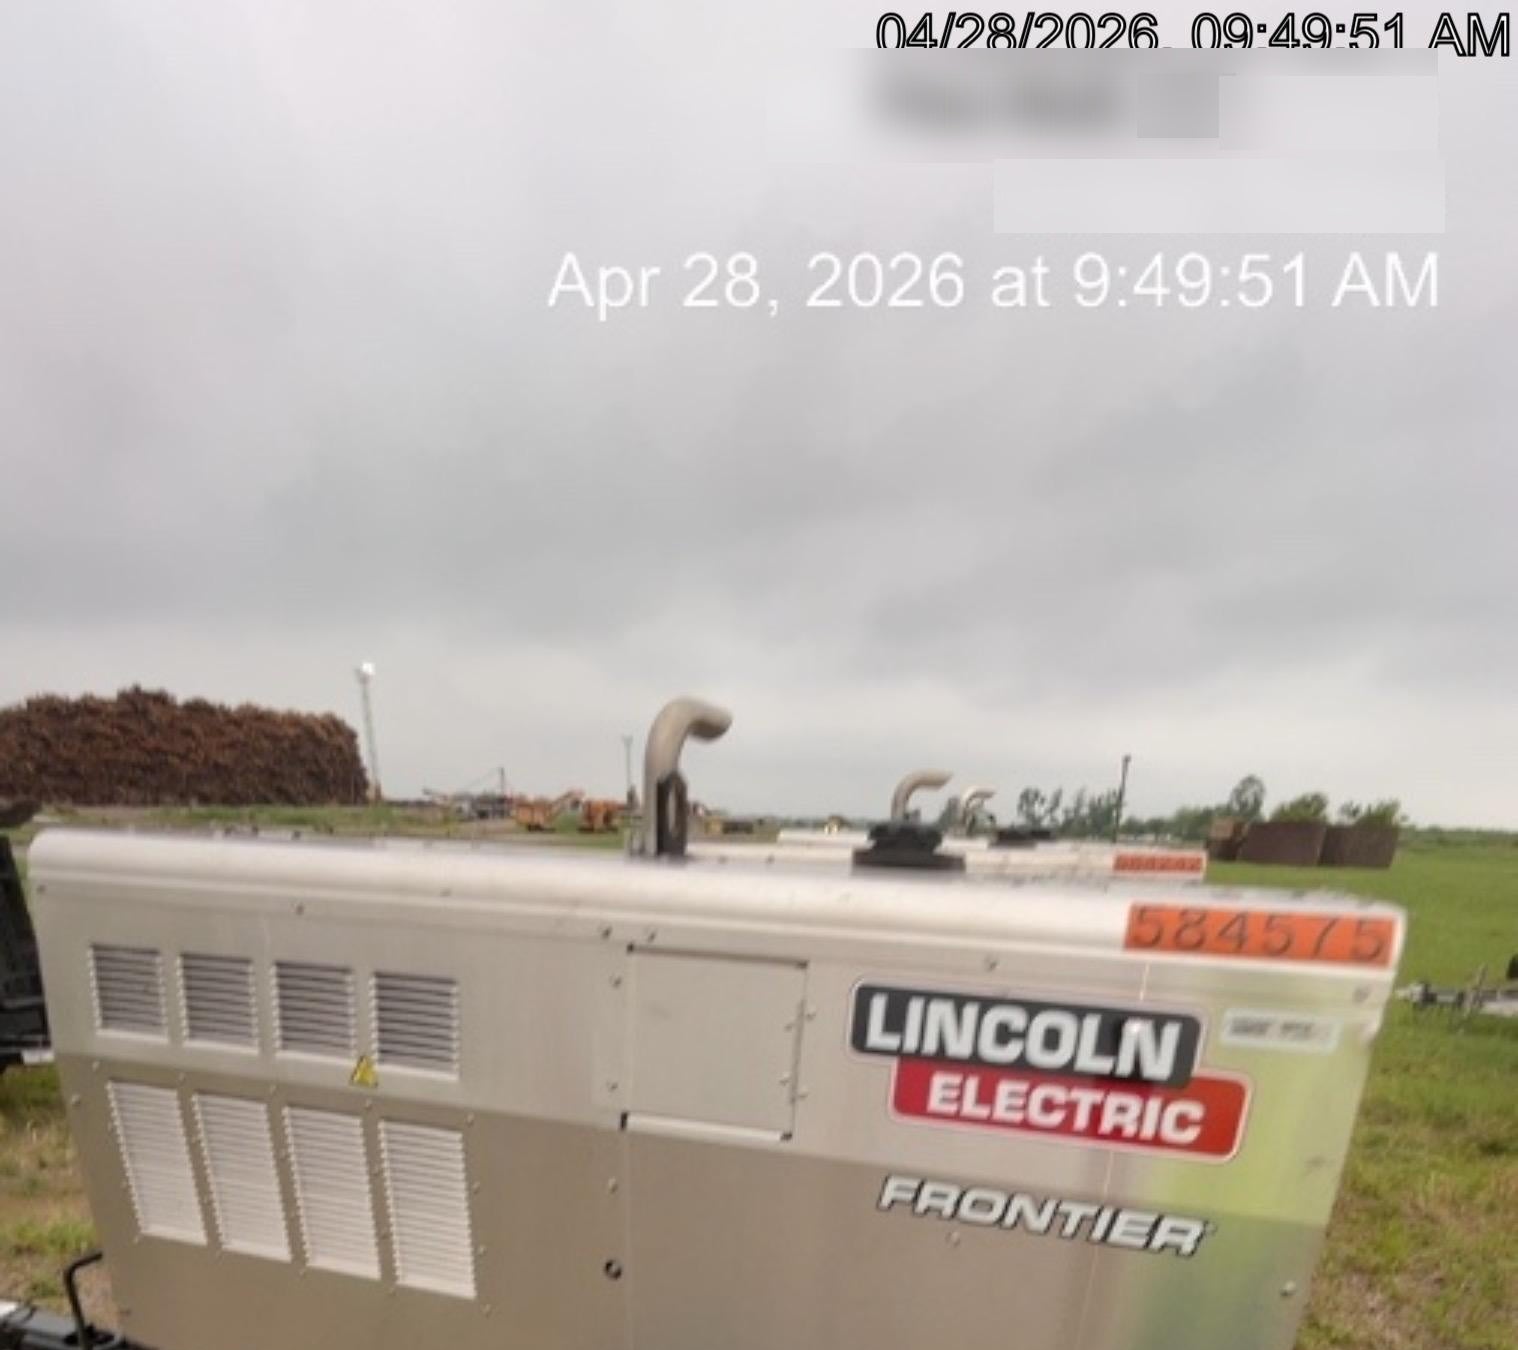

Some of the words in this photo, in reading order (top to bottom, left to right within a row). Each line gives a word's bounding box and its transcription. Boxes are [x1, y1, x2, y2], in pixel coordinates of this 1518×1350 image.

[1130, 906, 1388, 962] 584575
[865, 992, 1182, 1081] LINCOLN
[926, 1072, 1206, 1145] ELECTRIC
[876, 1174, 1209, 1257] FRONTIER
